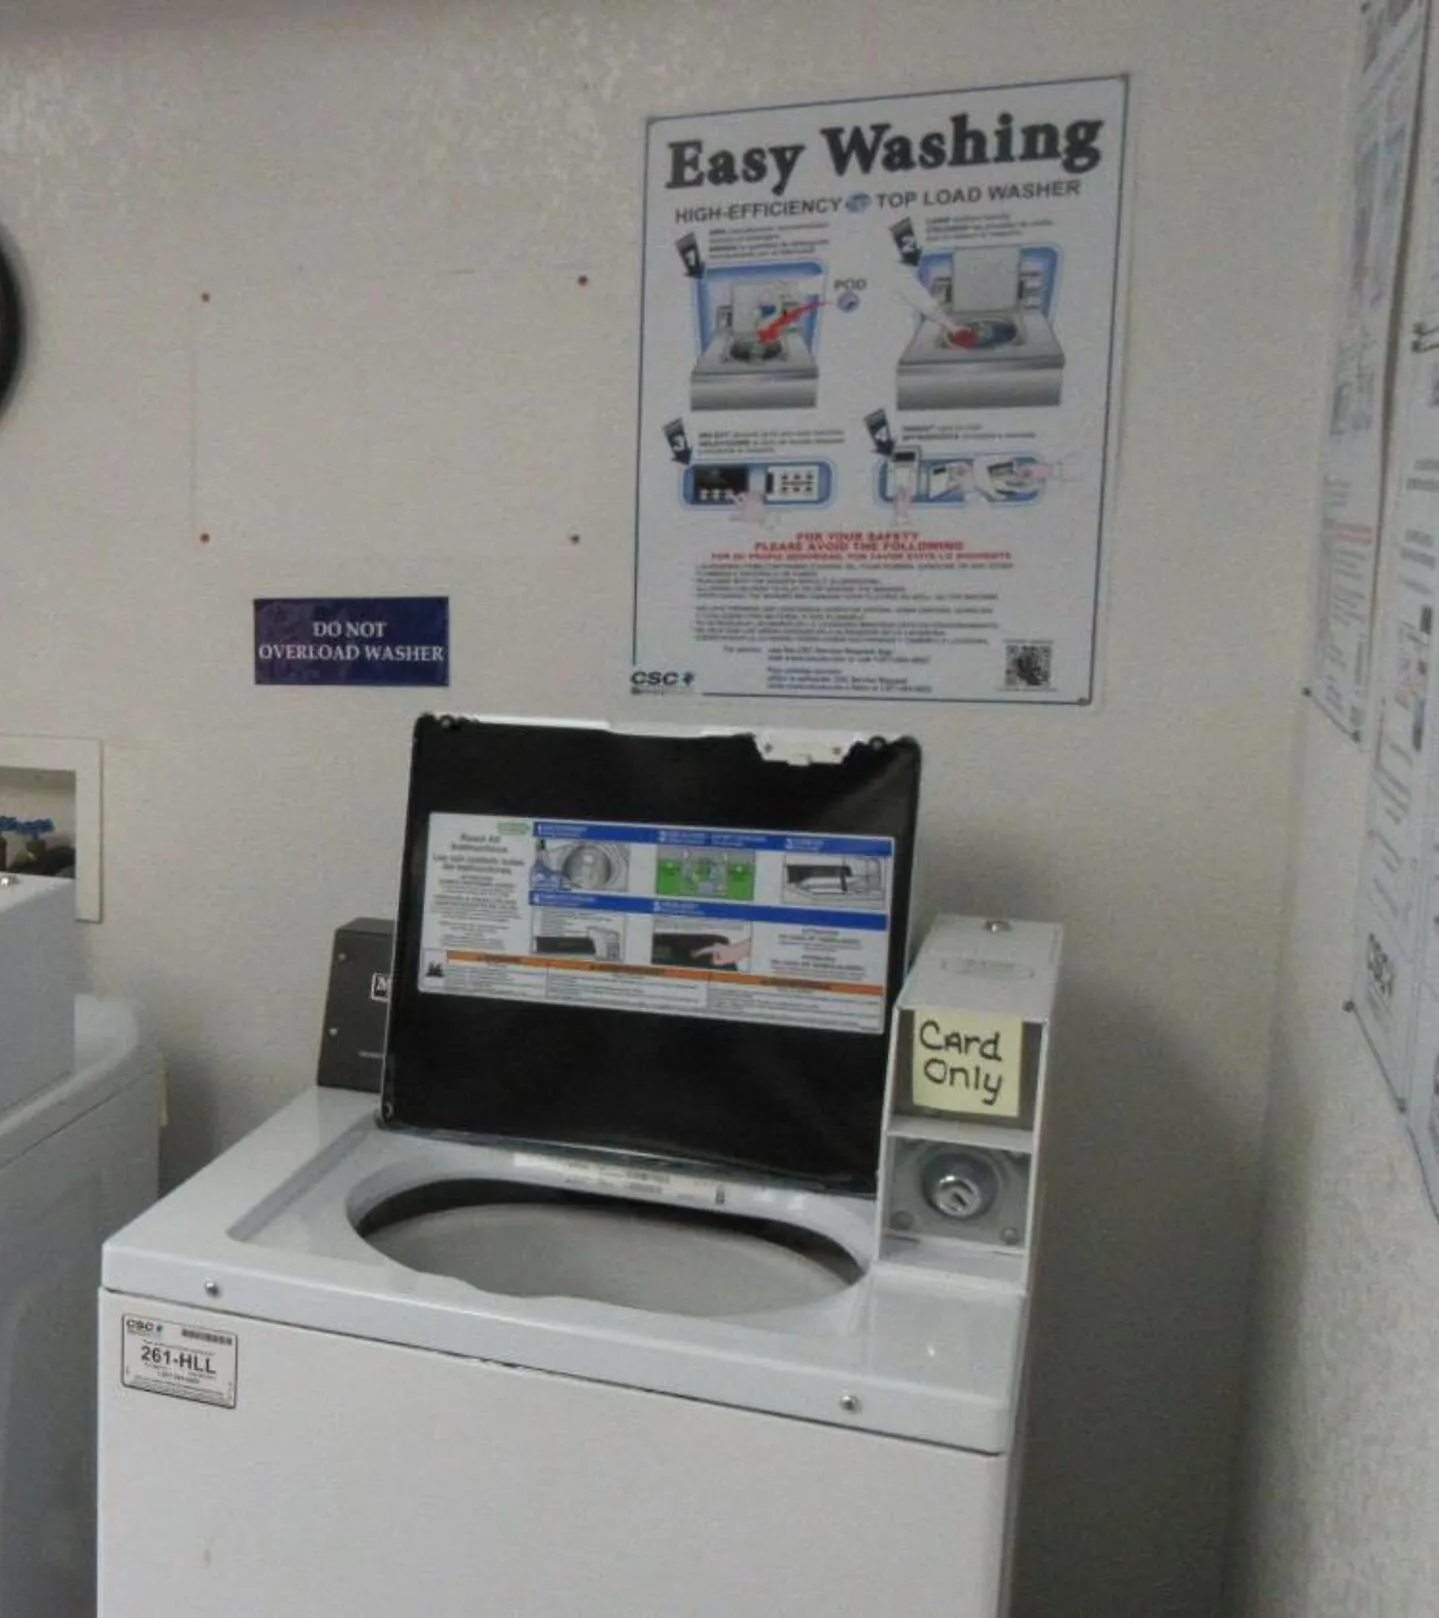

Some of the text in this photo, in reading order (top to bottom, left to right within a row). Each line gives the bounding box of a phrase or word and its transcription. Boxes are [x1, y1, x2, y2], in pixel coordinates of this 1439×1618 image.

[665, 112, 1105, 196] Easy Washing
[675, 179, 1082, 224] HIGH-EFFICIENCY TOP LOAD WASHER
[828, 532, 863, 541] YOUR
[868, 531, 920, 541] SAFETY
[754, 541, 803, 551] PLEASE
[808, 541, 849, 551] AVOID
[854, 541, 877, 551] THE
[312, 621, 388, 638] DO NOT
[258, 644, 445, 662] OVERLOAD WASHER
[630, 671, 679, 686] CSC
[923, 1057, 1003, 1106] Only
[141, 1345, 217, 1374] 261-HLL
